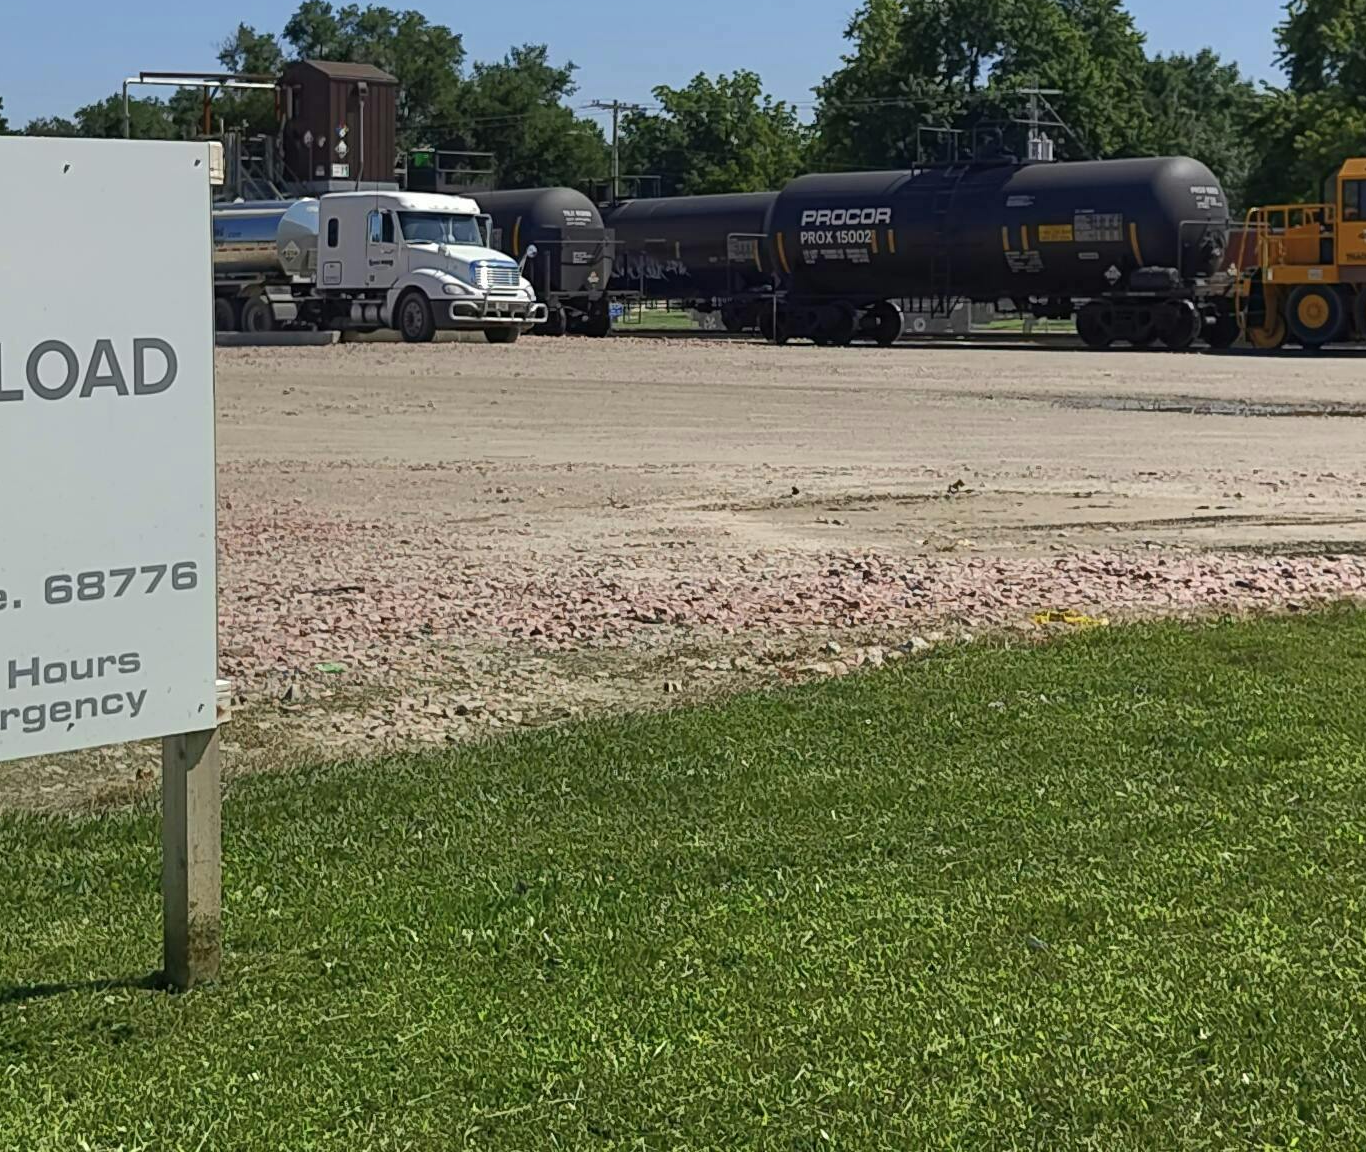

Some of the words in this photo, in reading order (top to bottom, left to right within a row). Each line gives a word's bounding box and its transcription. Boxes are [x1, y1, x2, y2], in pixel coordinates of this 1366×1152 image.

[801, 208, 892, 226] PROCOR
[800, 231, 834, 244] PROX
[835, 230, 872, 244] 15002
[44, 561, 199, 605] 68776
[8, 652, 142, 690] Hours
